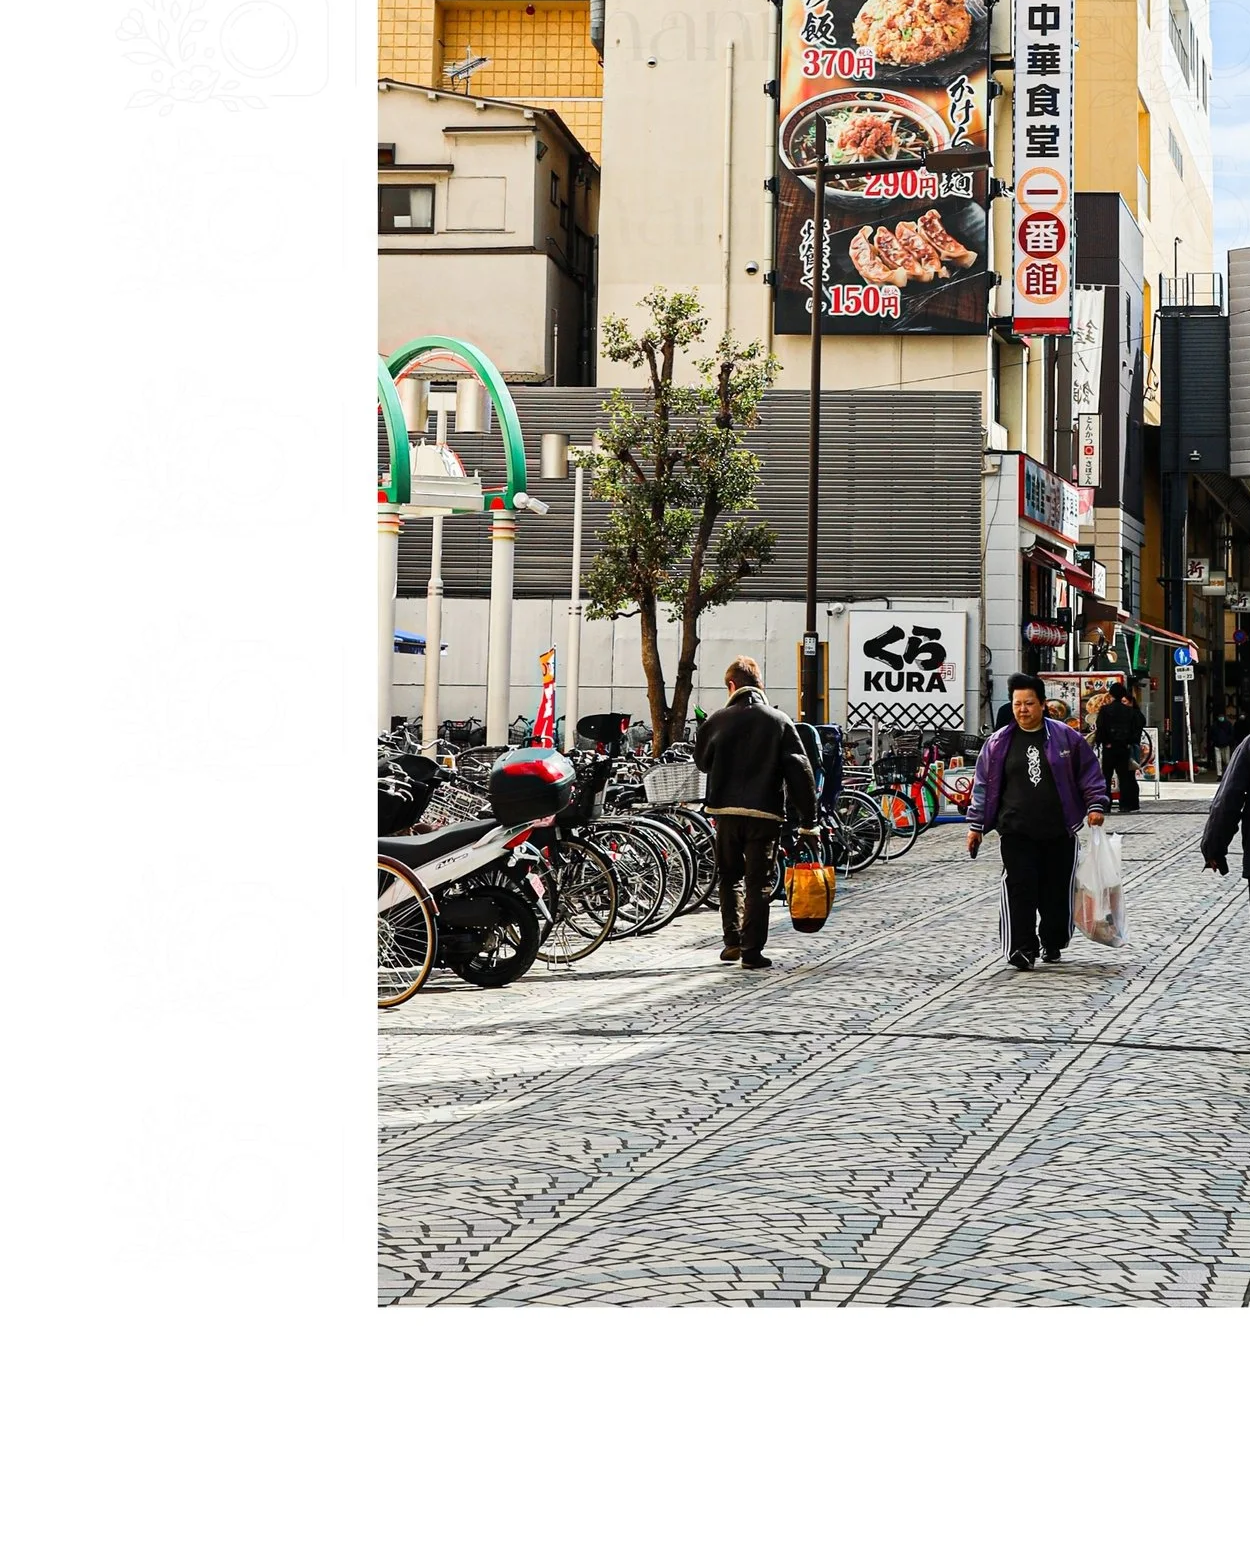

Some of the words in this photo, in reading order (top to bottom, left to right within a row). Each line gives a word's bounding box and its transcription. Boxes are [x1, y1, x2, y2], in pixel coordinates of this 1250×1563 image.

[803, 48, 876, 79] 370円
[1025, 3, 1061, 159] 中華食堂
[1024, 188, 1061, 296] 一番館
[830, 286, 900, 317] 150円
[1085, 415, 1093, 445] とんかつ
[863, 625, 948, 671] くら
[864, 671, 948, 693] KURA
